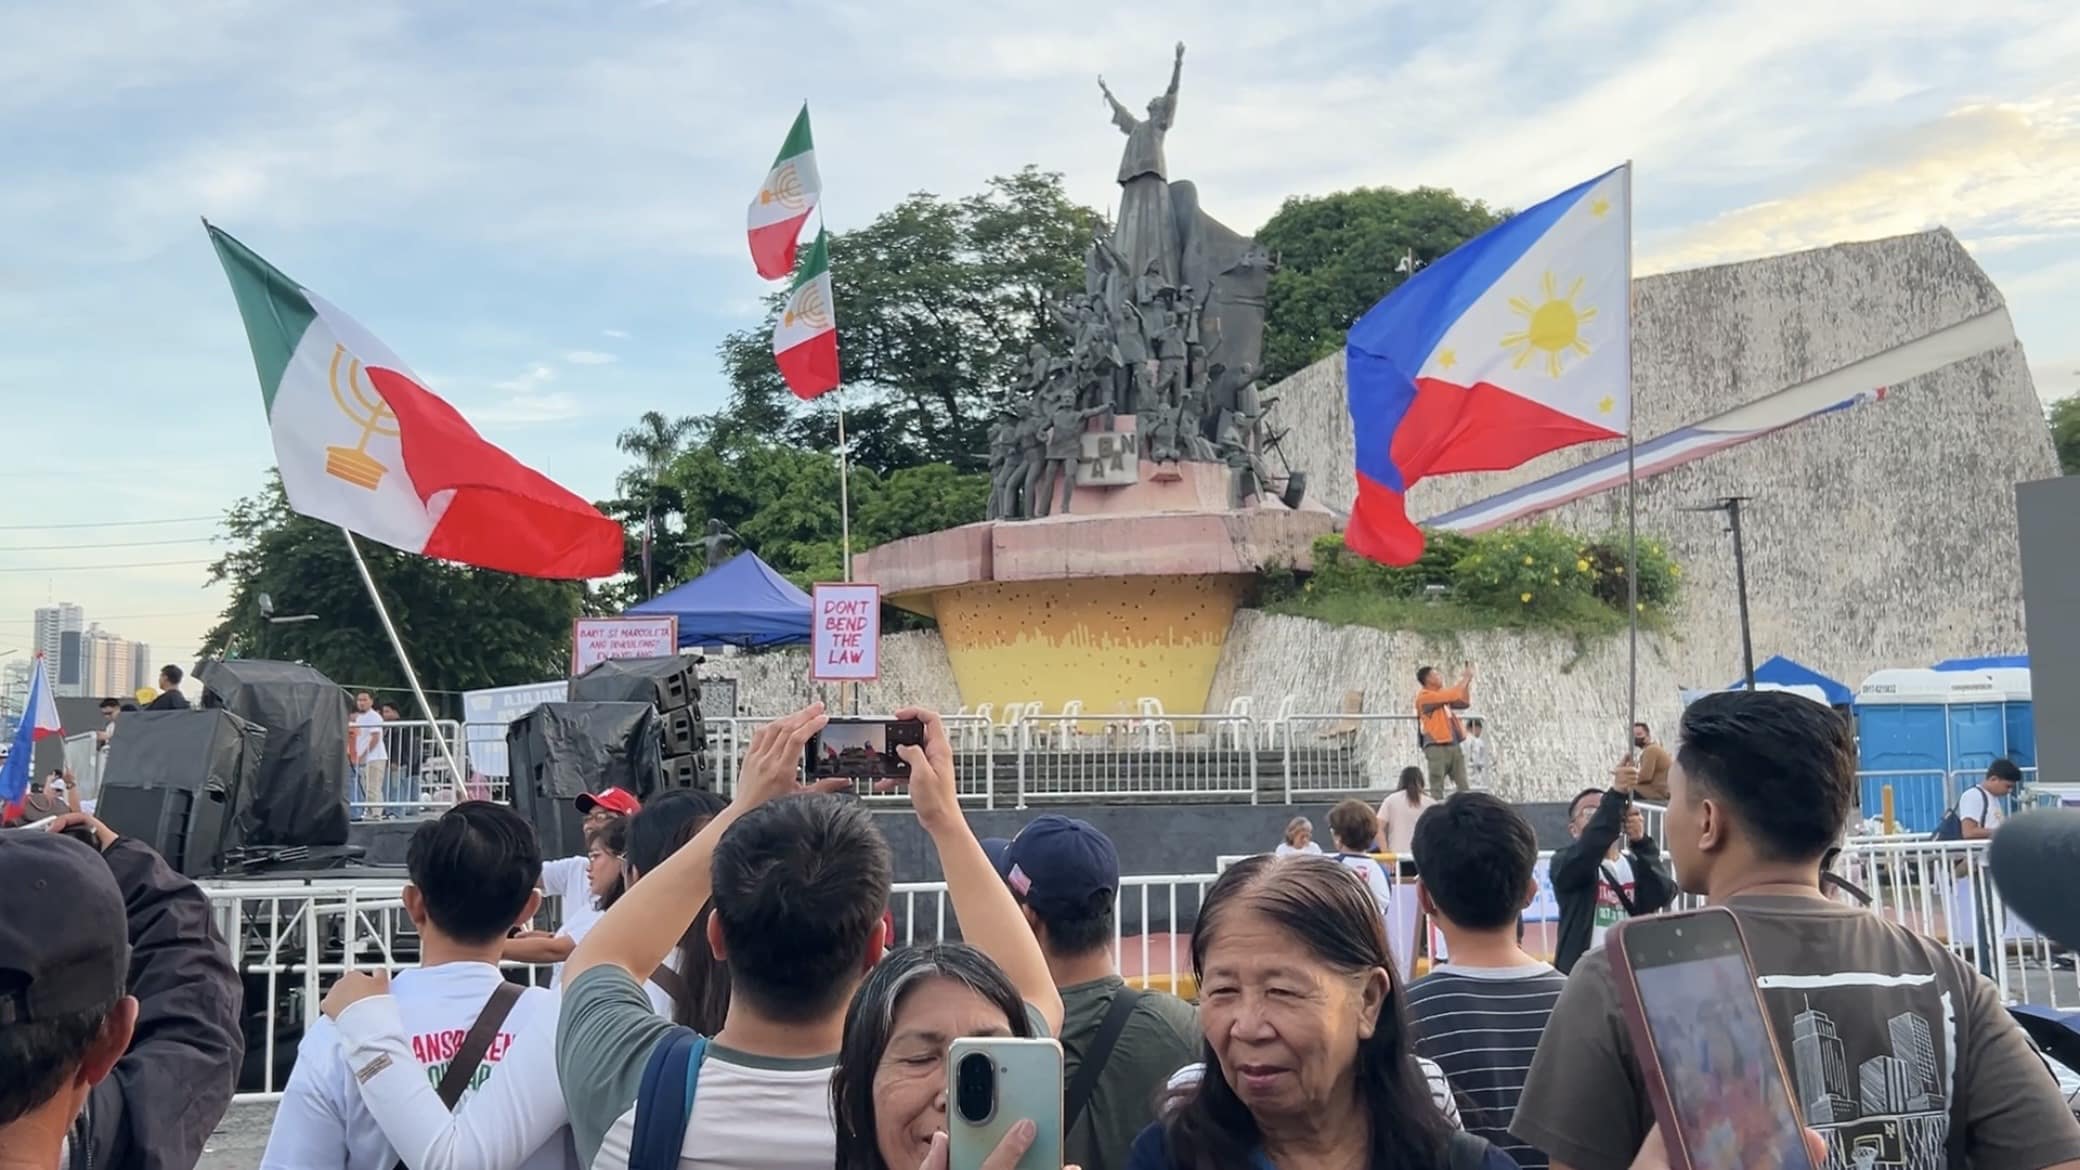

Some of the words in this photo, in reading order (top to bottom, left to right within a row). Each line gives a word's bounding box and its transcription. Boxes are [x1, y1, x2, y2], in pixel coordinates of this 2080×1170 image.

[825, 617, 868, 632] BEND
[832, 633, 862, 647] THE
[828, 649, 864, 664] LAW
